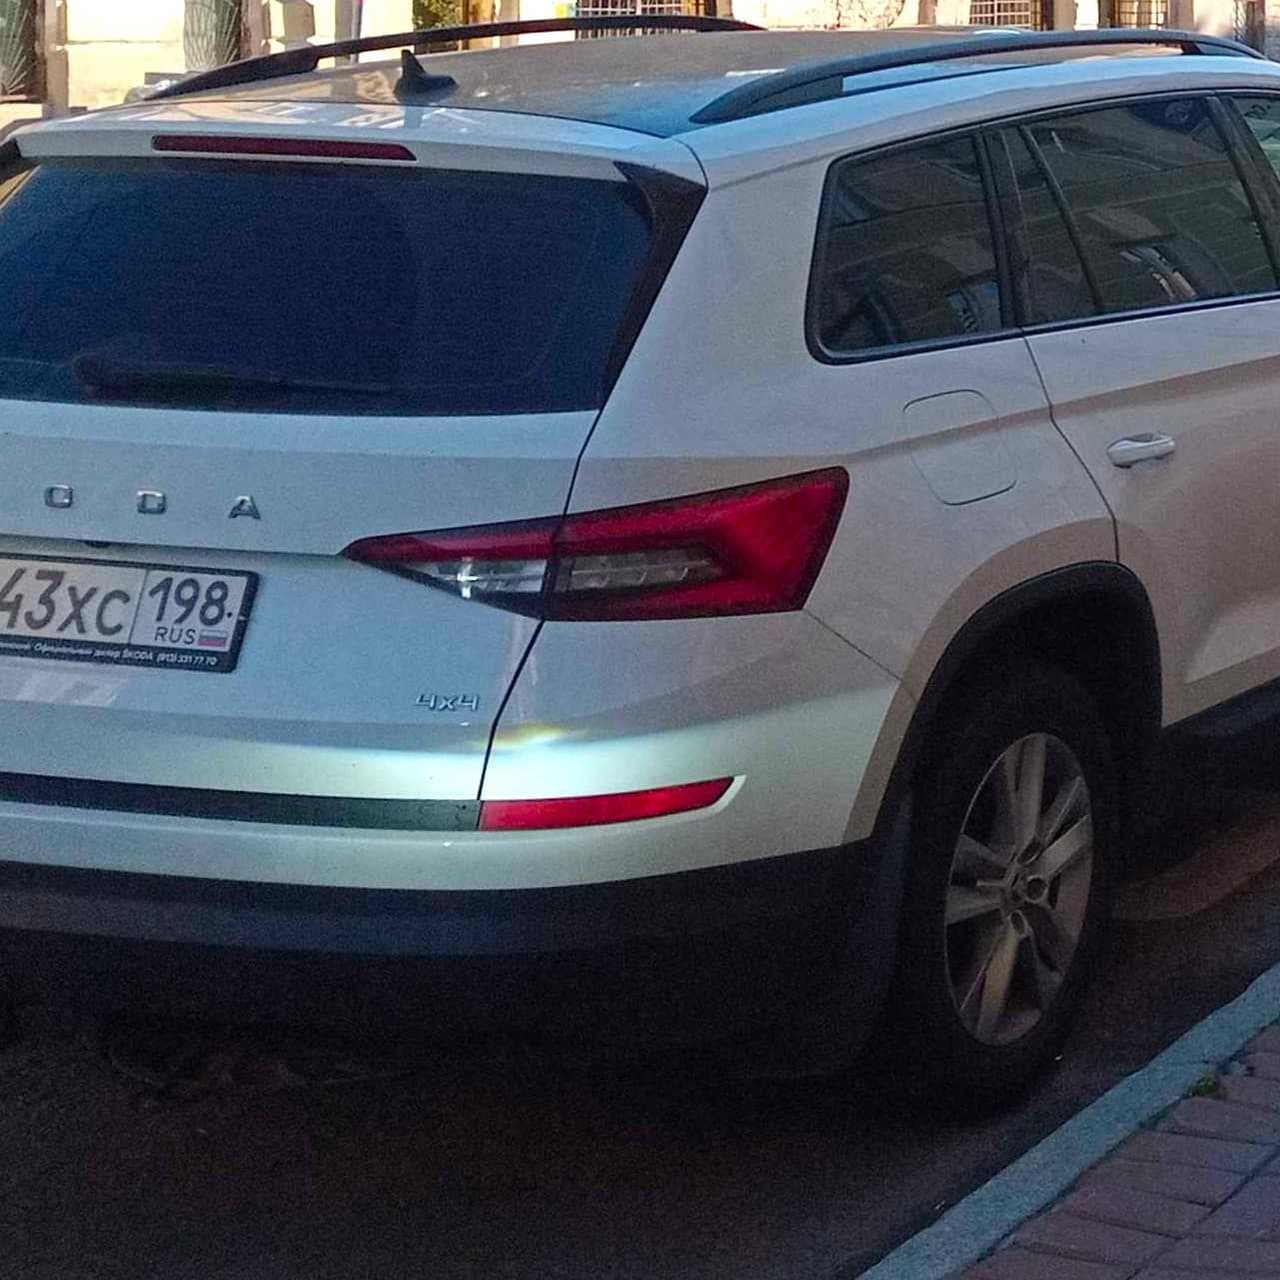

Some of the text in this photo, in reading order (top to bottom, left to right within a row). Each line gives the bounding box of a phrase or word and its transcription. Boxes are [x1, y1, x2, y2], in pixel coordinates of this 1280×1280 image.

[149, 576, 229, 626] 198
[155, 626, 197, 645] RUS
[413, 694, 480, 712] 4x4
